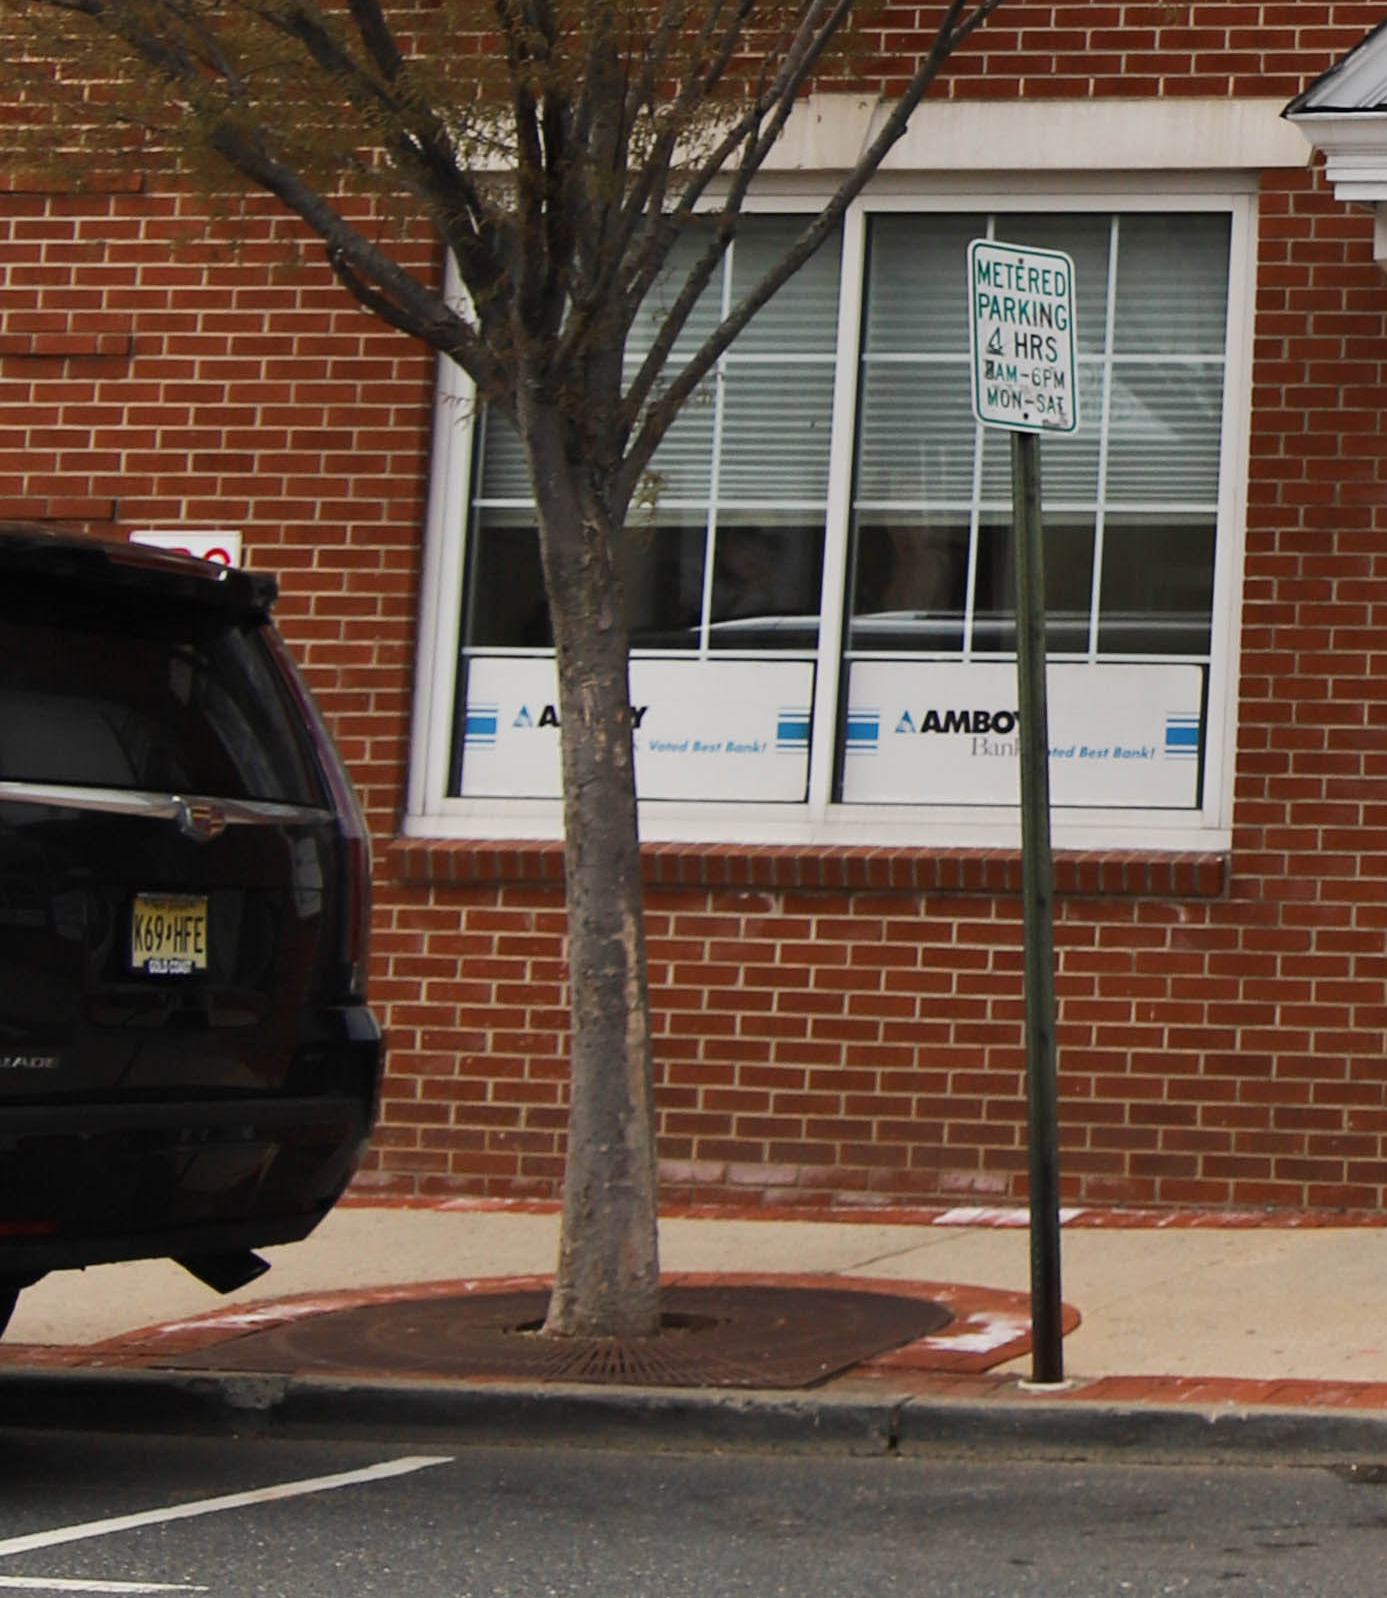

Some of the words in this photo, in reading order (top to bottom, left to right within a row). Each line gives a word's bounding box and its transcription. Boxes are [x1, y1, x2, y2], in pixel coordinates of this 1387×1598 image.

[977, 258, 1066, 298] METERED
[978, 292, 1068, 331] PARKING
[1014, 331, 1059, 363] HRS
[987, 387, 1065, 415] MON-SAT
[648, 740, 688, 753] Voted
[692, 741, 723, 753] Best
[725, 741, 768, 754] Bank!
[1079, 747, 1109, 759] Best
[1112, 747, 1156, 760] Bank!
